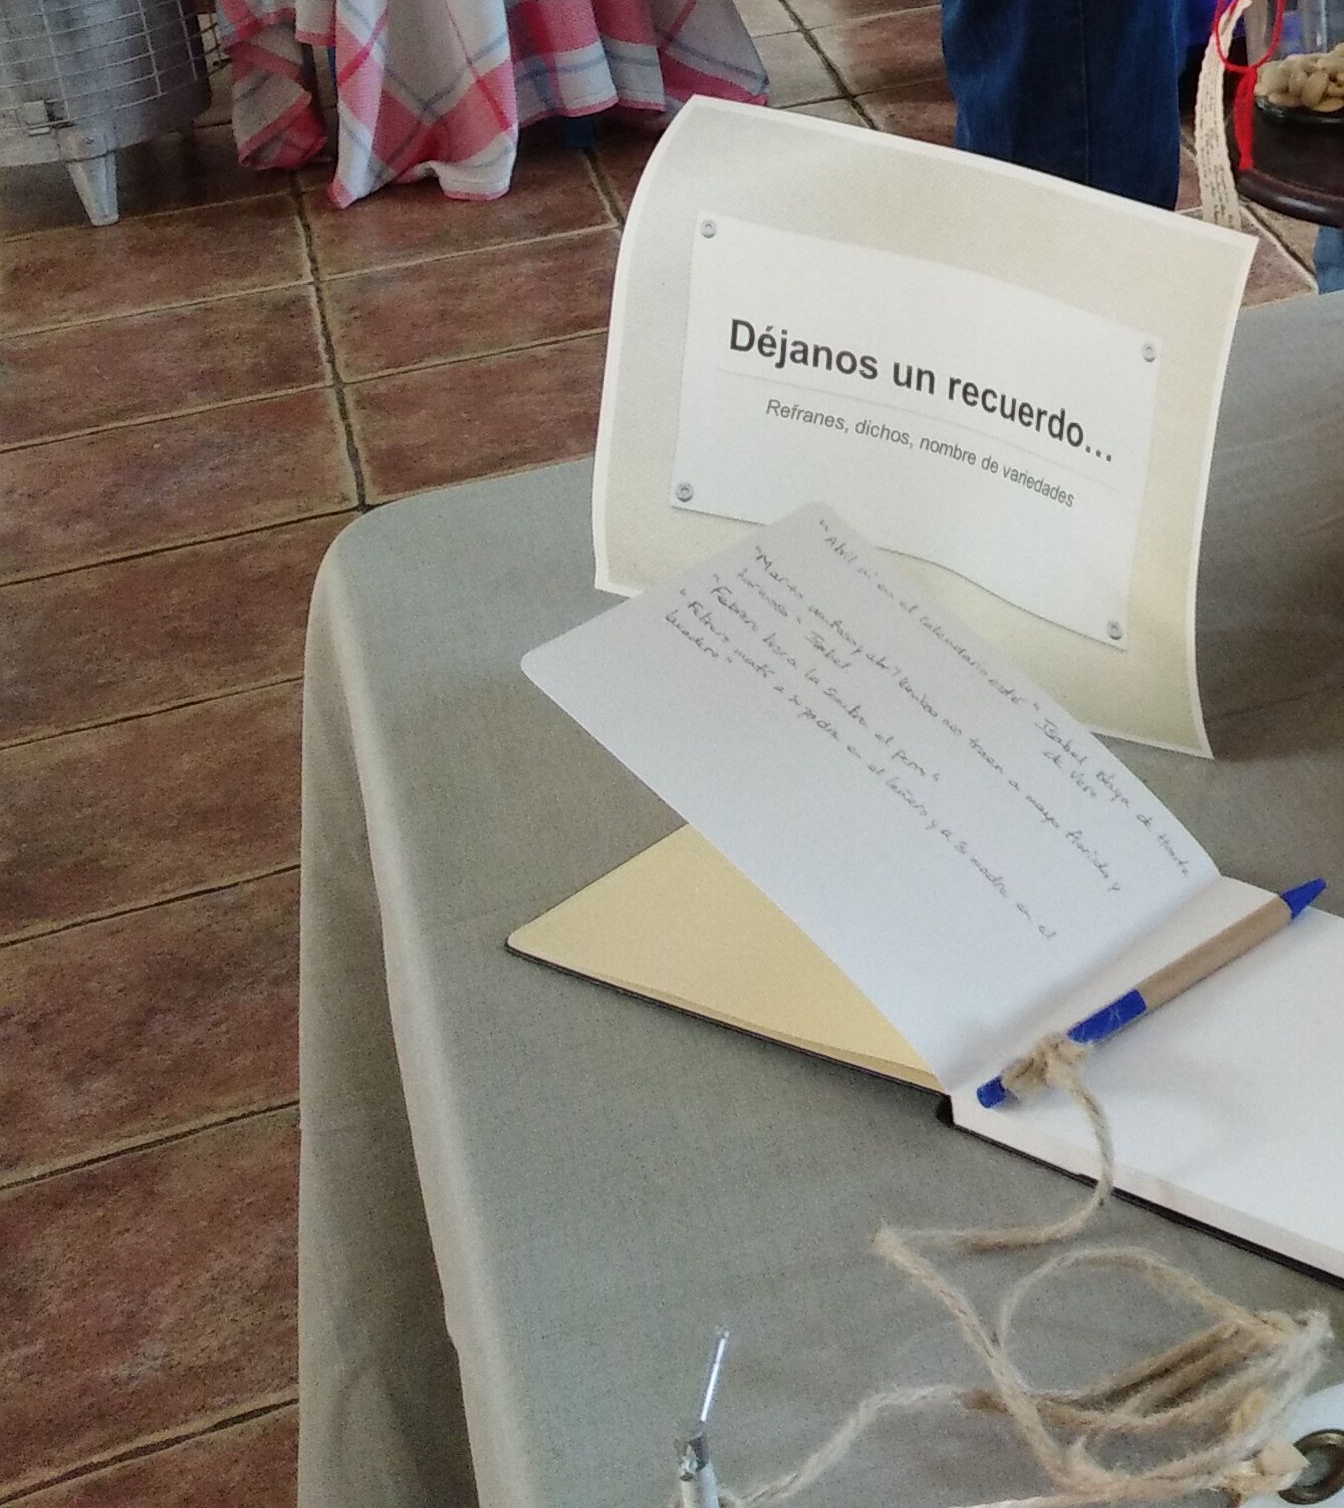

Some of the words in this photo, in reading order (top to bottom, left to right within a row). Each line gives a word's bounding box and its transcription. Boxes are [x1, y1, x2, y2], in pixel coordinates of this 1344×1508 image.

[730, 319, 879, 380] Déjanos
[892, 360, 936, 395] un
[948, 374, 1114, 462] recuerdo...
[766, 399, 850, 432] Refranes,
[854, 418, 914, 449] dichos,
[919, 434, 977, 466] nombre
[981, 451, 1000, 474] de
[1002, 460, 1075, 509] variedades
